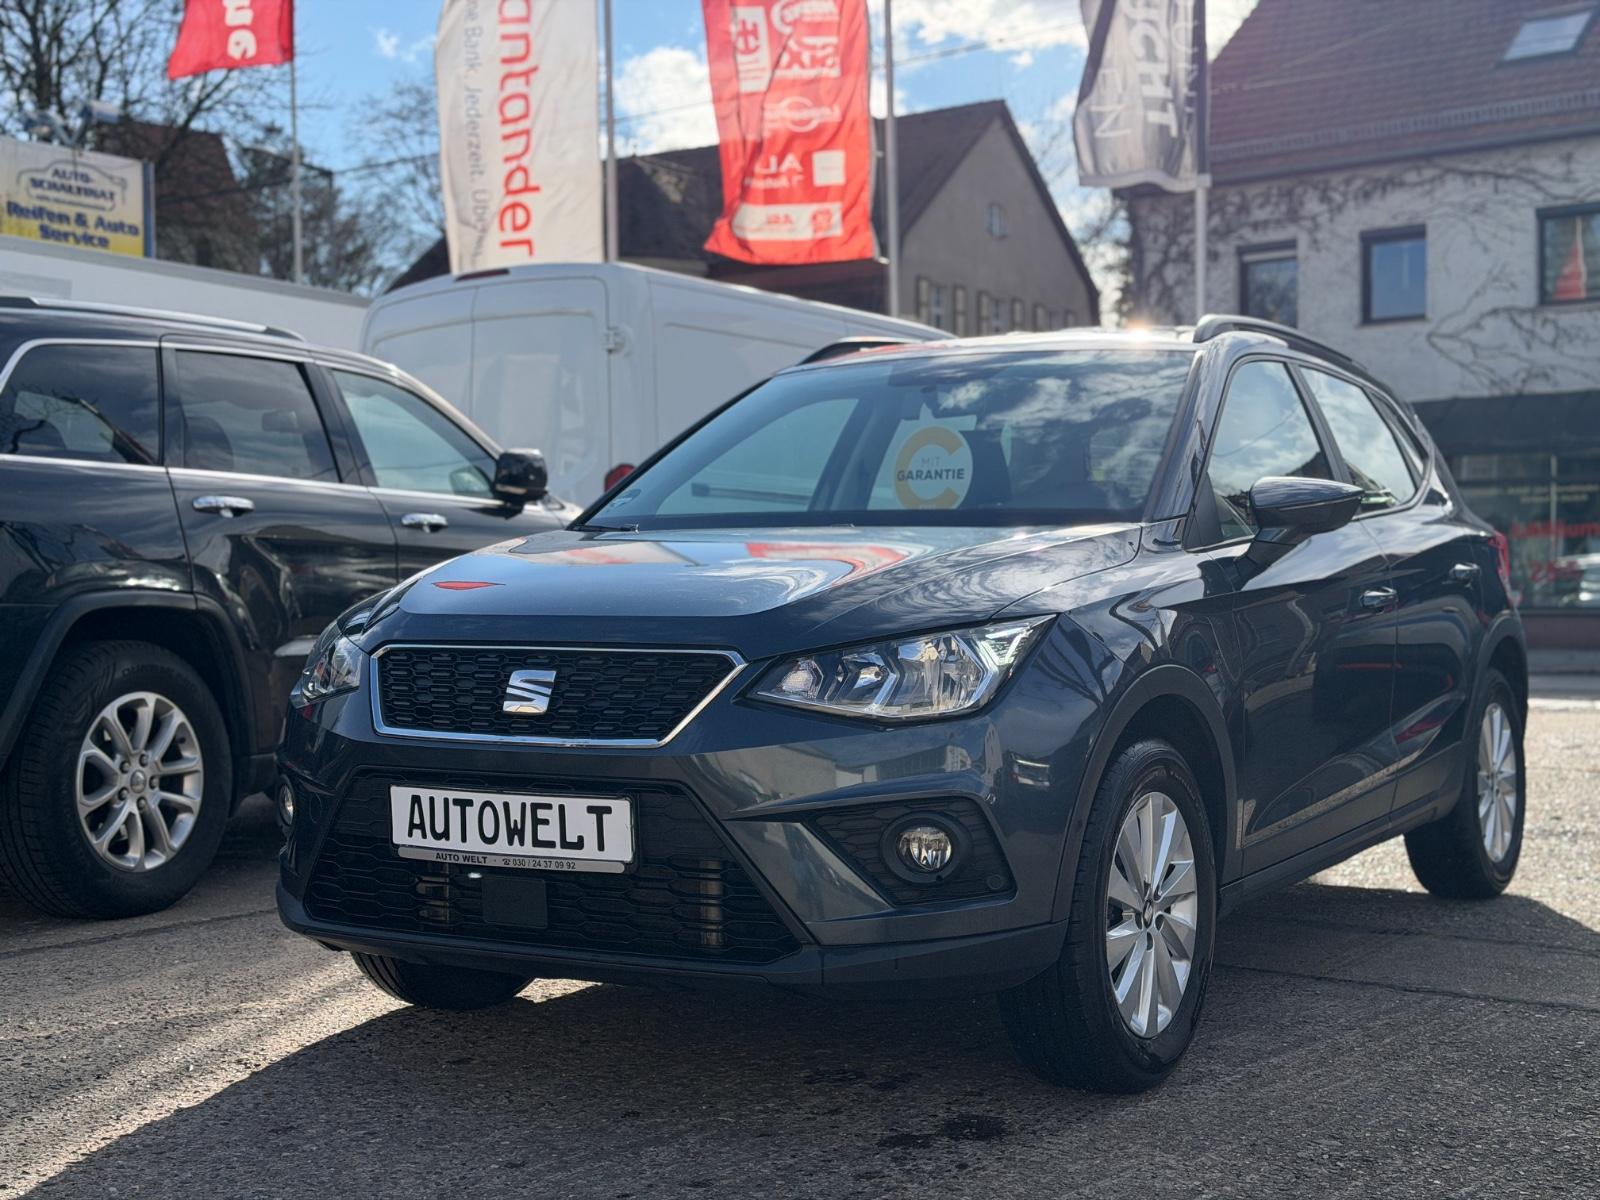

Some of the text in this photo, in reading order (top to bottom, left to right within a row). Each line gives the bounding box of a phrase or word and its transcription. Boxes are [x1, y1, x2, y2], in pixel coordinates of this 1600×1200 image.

[7, 200, 71, 226] Reifen
[74, 211, 89, 230] &
[95, 215, 139, 237] Auto
[39, 223, 110, 249] Service
[896, 468, 965, 481] GARANTIE
[407, 794, 613, 852] AUTOWELT
[435, 852, 460, 863] AUTO
[462, 854, 488, 865] WELT
[512, 859, 526, 868] 030
[532, 860, 542, 868] 24
[543, 861, 553, 869] 37
[554, 861, 565, 869] 09
[565, 862, 576, 870] 92
